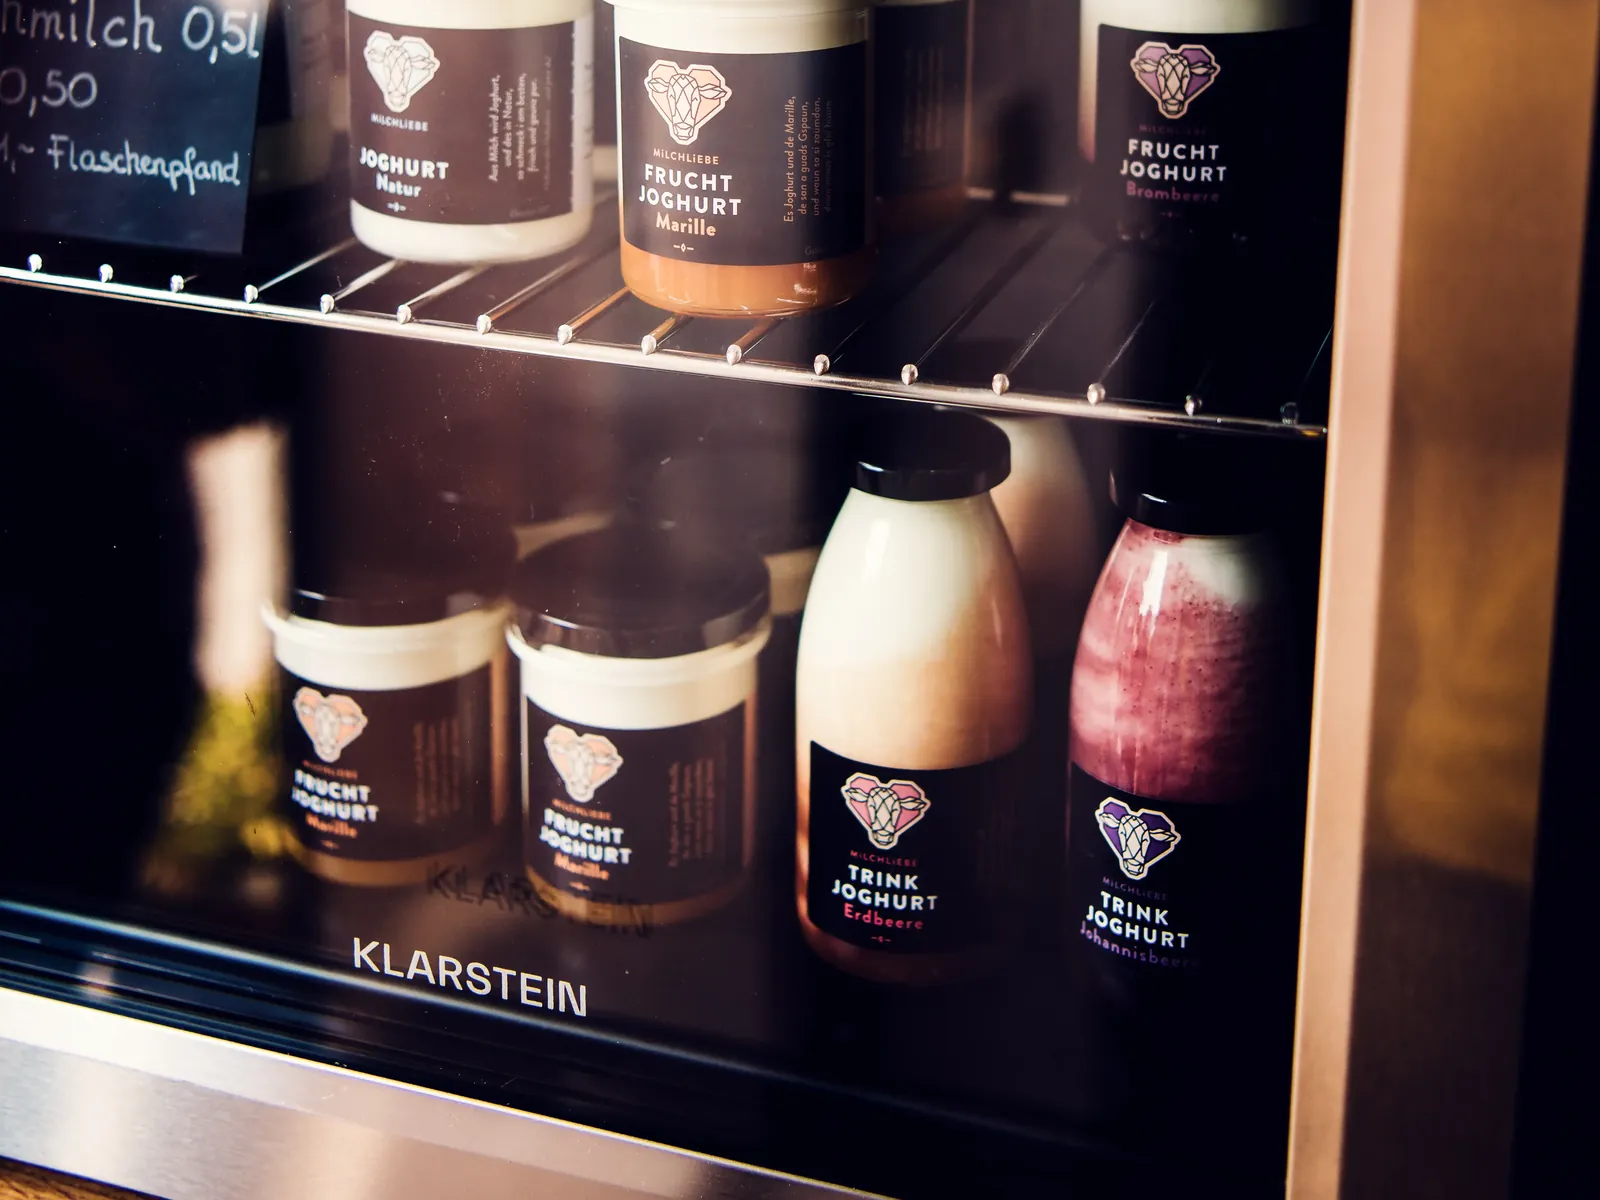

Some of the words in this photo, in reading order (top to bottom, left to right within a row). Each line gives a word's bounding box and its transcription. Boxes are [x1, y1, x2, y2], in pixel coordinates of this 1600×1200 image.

[785, 96, 797, 134] Marille,
[798, 101, 811, 142] Gspaun,
[785, 136, 794, 148] de
[1128, 139, 1219, 160] FRUCHT
[47, 133, 241, 196] Flaschenpfand
[360, 147, 449, 179] JOGHURT
[503, 148, 512, 168] und
[785, 150, 794, 169] und
[799, 145, 810, 173] guads
[1120, 159, 1227, 182] JOGHURT
[376, 173, 421, 197] Natur
[644, 163, 732, 192] FRUCHT
[784, 172, 797, 209] Joghurt
[639, 185, 741, 216] JOGHURT
[798, 203, 807, 215] de
[812, 198, 820, 216] und
[656, 212, 716, 236] Marille
[784, 211, 794, 222] Es
[294, 769, 371, 803] FRUCHT
[291, 786, 379, 822] JOGHURT
[544, 807, 624, 845] FRUCHT
[539, 825, 632, 864] JOGHURT
[848, 864, 918, 891] TRINK
[831, 879, 938, 911] JOGHURT
[1100, 890, 1169, 926] TRINK
[843, 902, 924, 930] Erdbeere
[1086, 905, 1189, 949] JOGHURT
[353, 936, 587, 1018] KLARSTEIN
